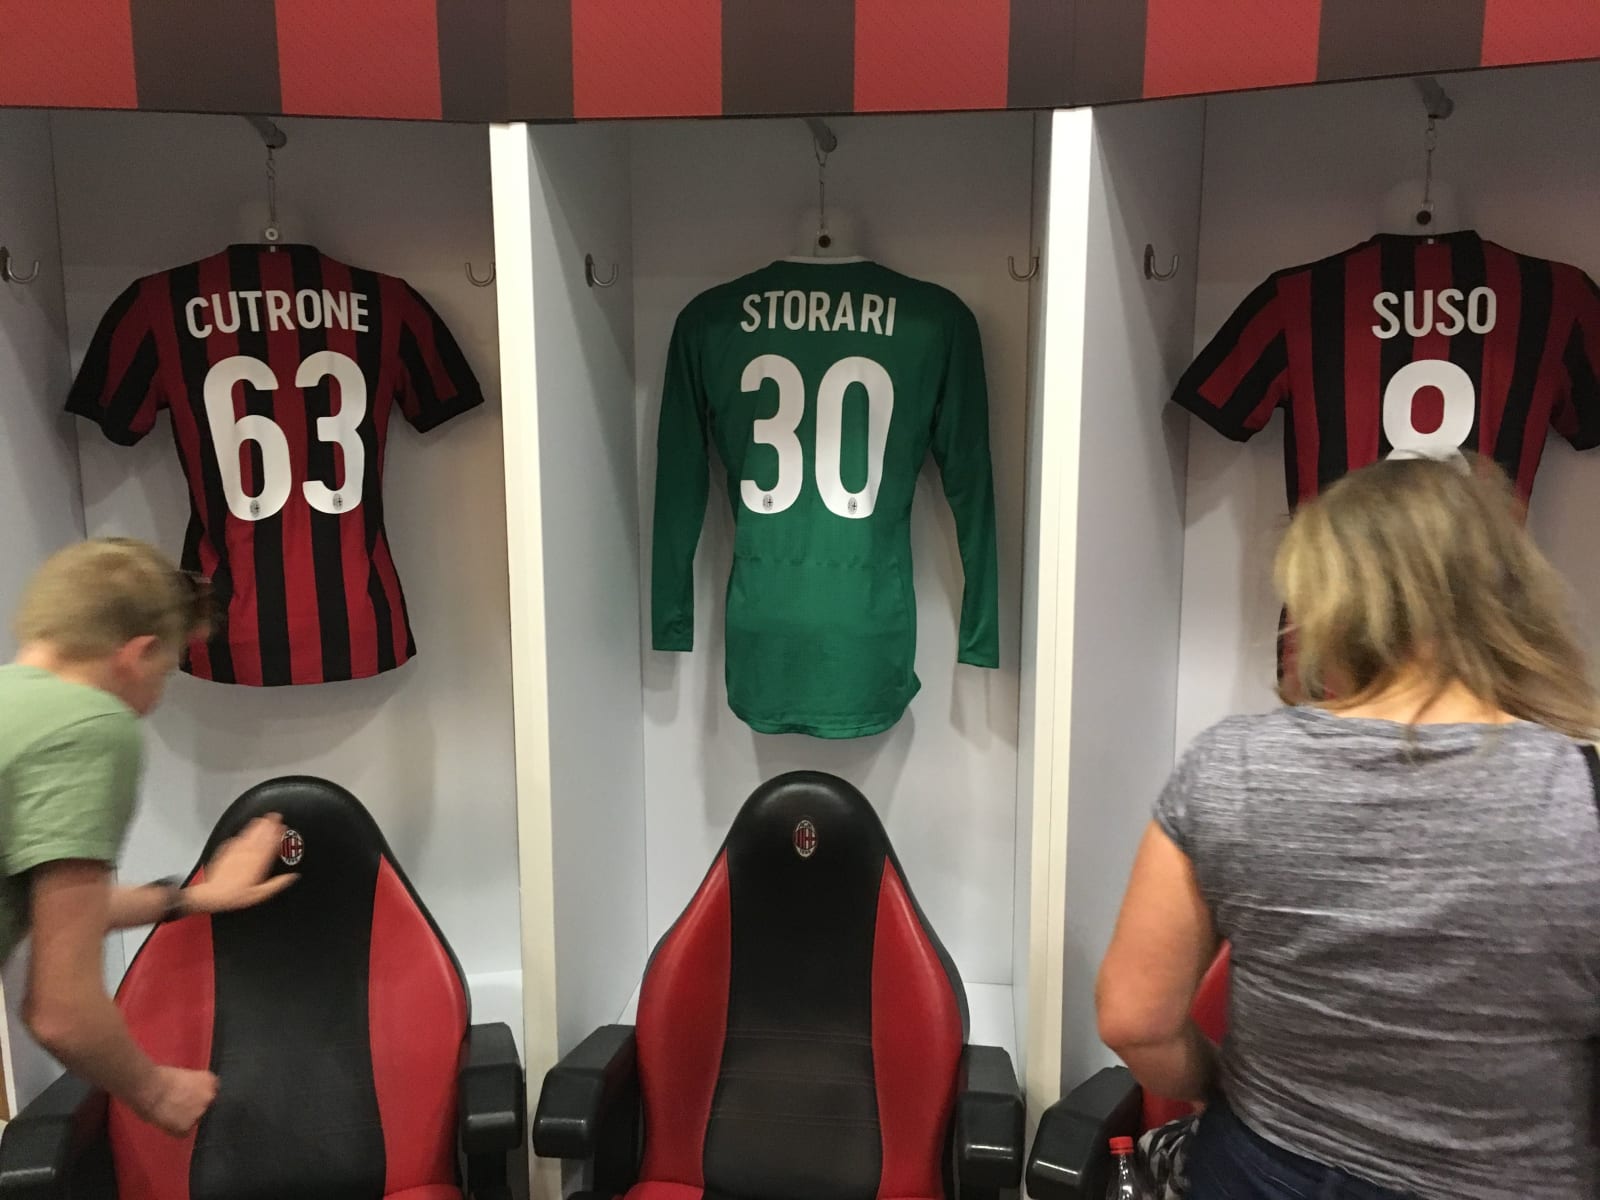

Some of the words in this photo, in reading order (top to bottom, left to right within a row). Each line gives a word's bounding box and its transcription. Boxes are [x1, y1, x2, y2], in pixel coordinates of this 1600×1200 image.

[184, 288, 369, 339] CUTRONE
[740, 290, 897, 336] STORARI
[1372, 286, 1497, 339] SUSO
[203, 350, 367, 521] 63
[739, 353, 895, 519] 30
